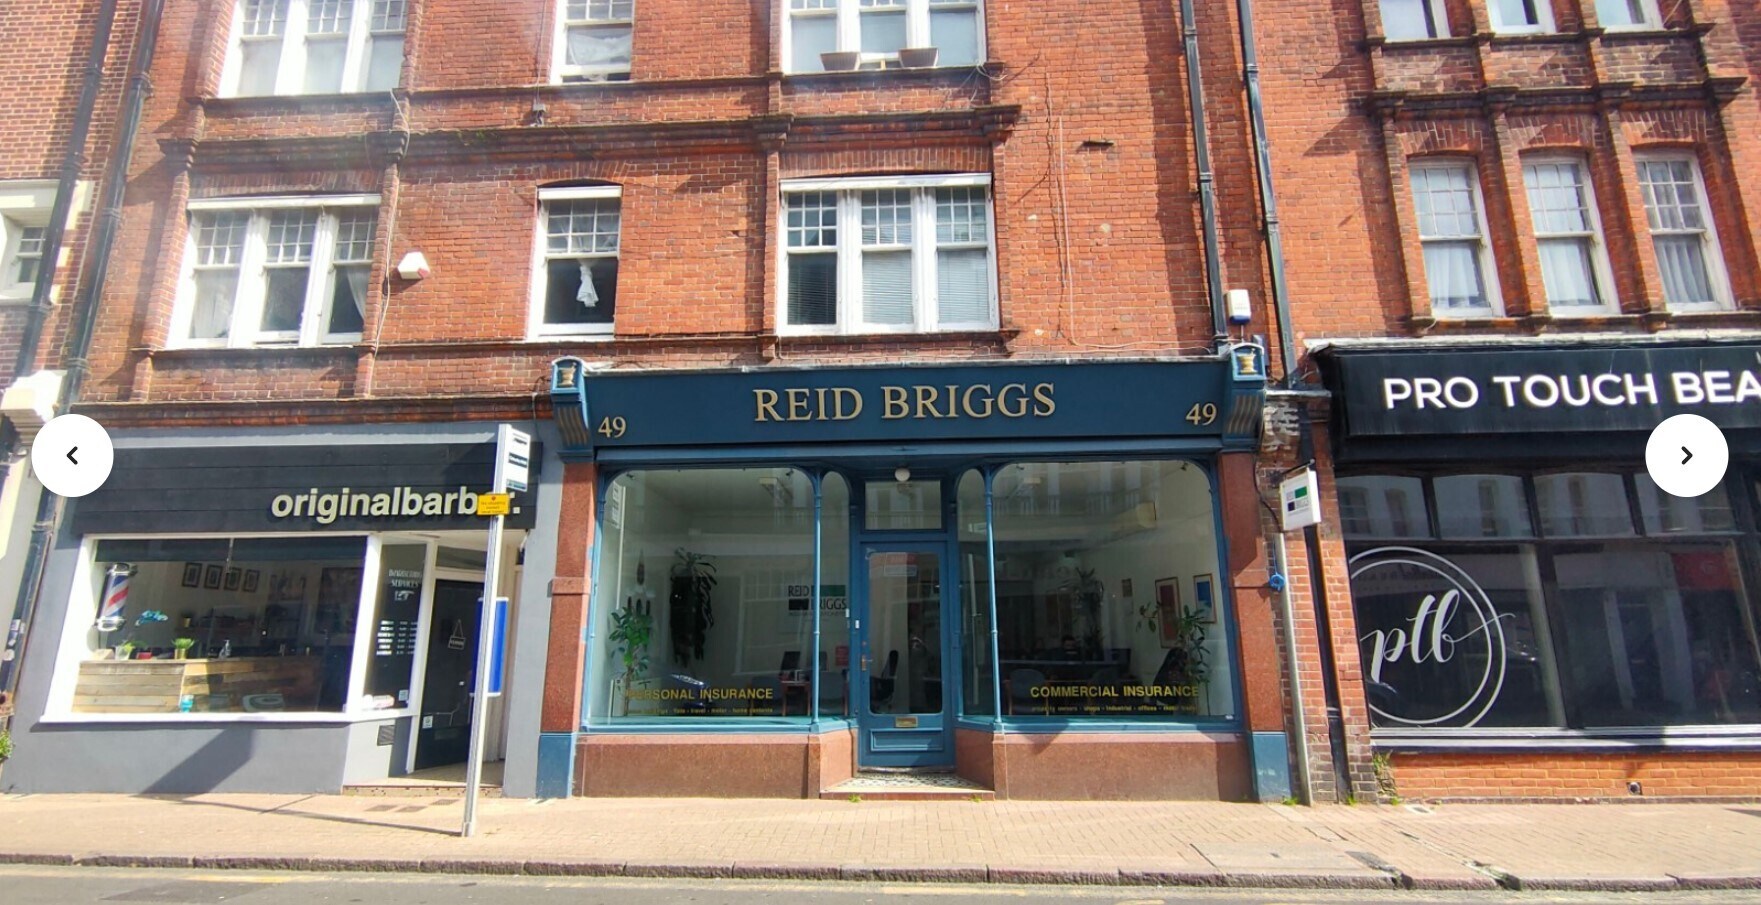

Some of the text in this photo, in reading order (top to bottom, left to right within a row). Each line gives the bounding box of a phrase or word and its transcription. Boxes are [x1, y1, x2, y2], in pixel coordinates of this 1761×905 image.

[1383, 369, 1761, 410] PRO TOUCH BEA
[752, 382, 1058, 423] REID BRIGGS
[1185, 402, 1218, 428] 49
[597, 415, 628, 439] 49
[271, 486, 520, 524] originalbarb.
[788, 585, 810, 597] REID
[627, 687, 774, 700] PERSONAL INSURANCE
[1029, 684, 1199, 698] COMMERCIAL INSURANCE
